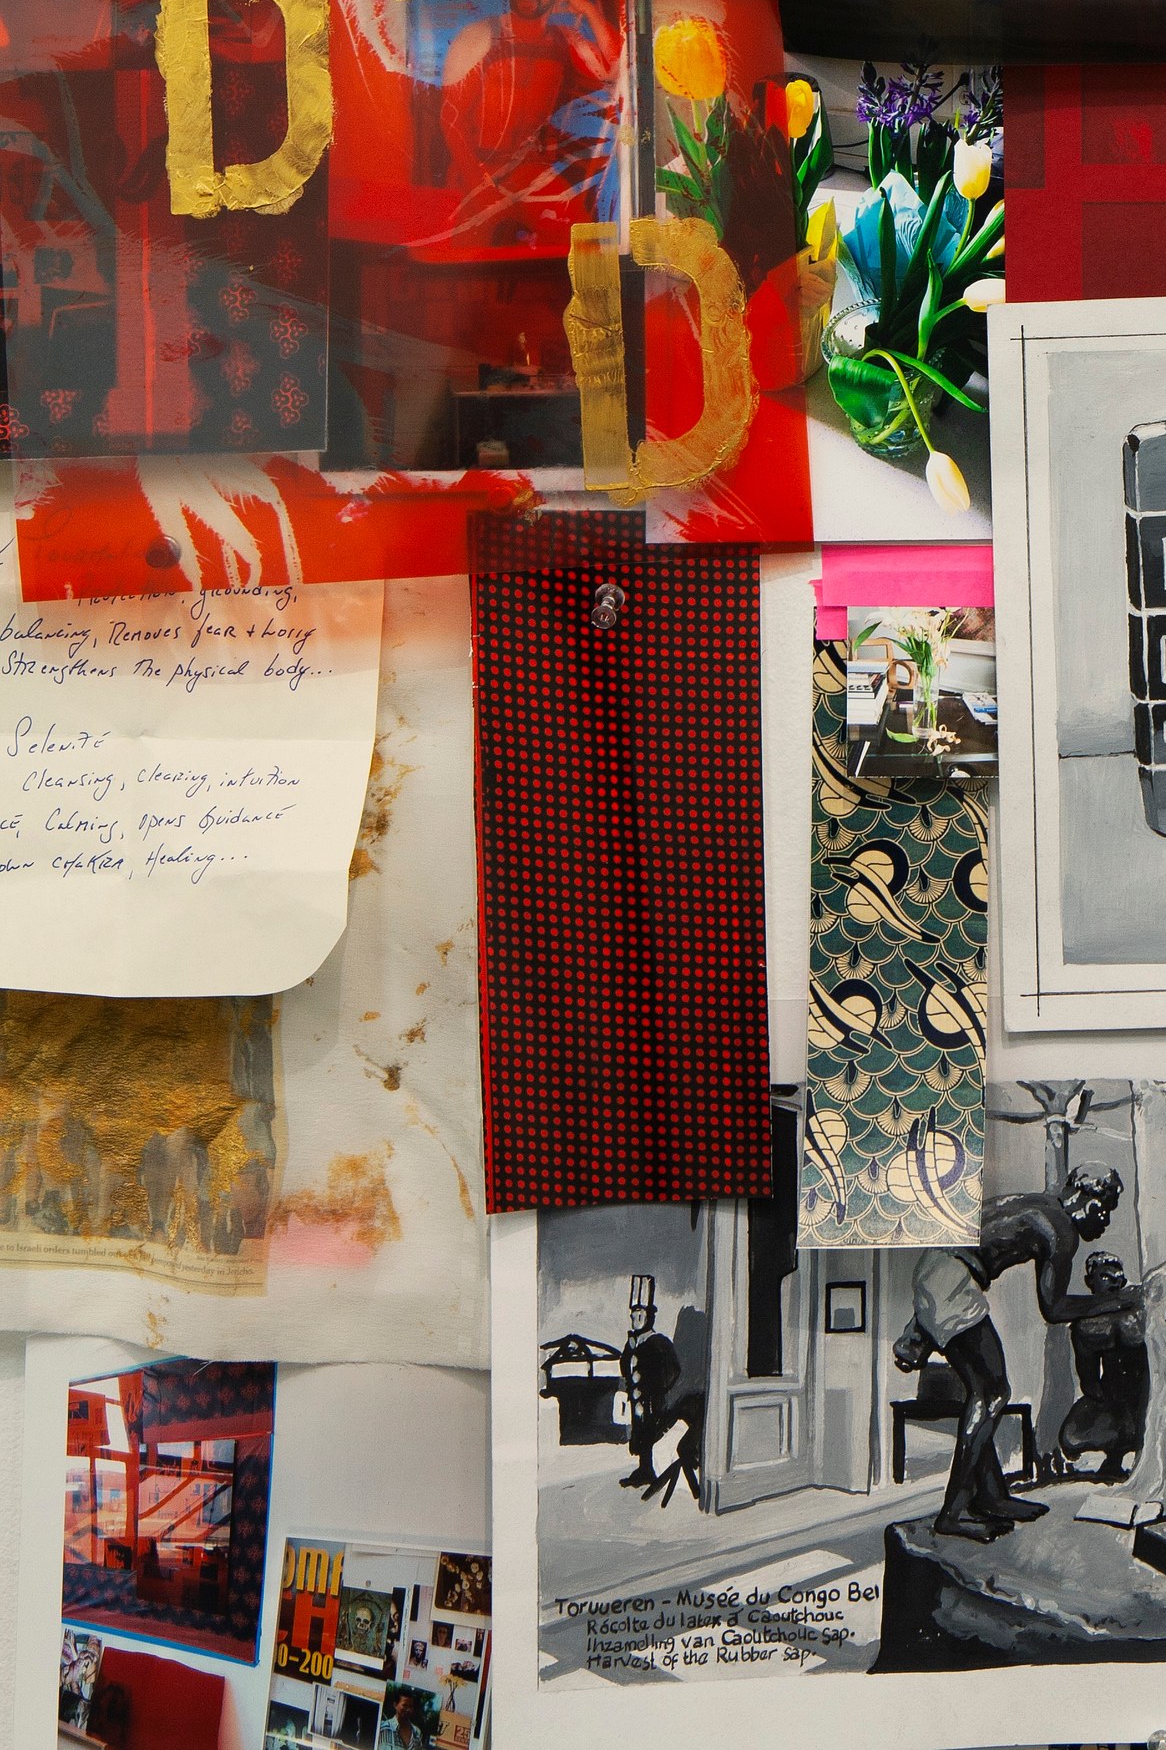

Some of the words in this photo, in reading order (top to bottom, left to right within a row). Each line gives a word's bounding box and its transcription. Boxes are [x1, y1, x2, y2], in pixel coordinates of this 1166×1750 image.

[564, 216, 760, 508] D
[17, 1242, 41, 1252] Israeli
[43, 1246, 71, 1255] orders
[71, 1247, 107, 1258] tumbled
[676, 1586, 740, 1610] Musée
[746, 1586, 770, 1604] du
[778, 1585, 841, 1608] Congo
[747, 1606, 845, 1624] Caoutchouc
[681, 1635, 715, 1649] van
[586, 1651, 657, 1671] Harvest
[663, 1652, 681, 1670] of
[683, 1649, 709, 1666] the
[716, 1646, 778, 1664] Rubber
